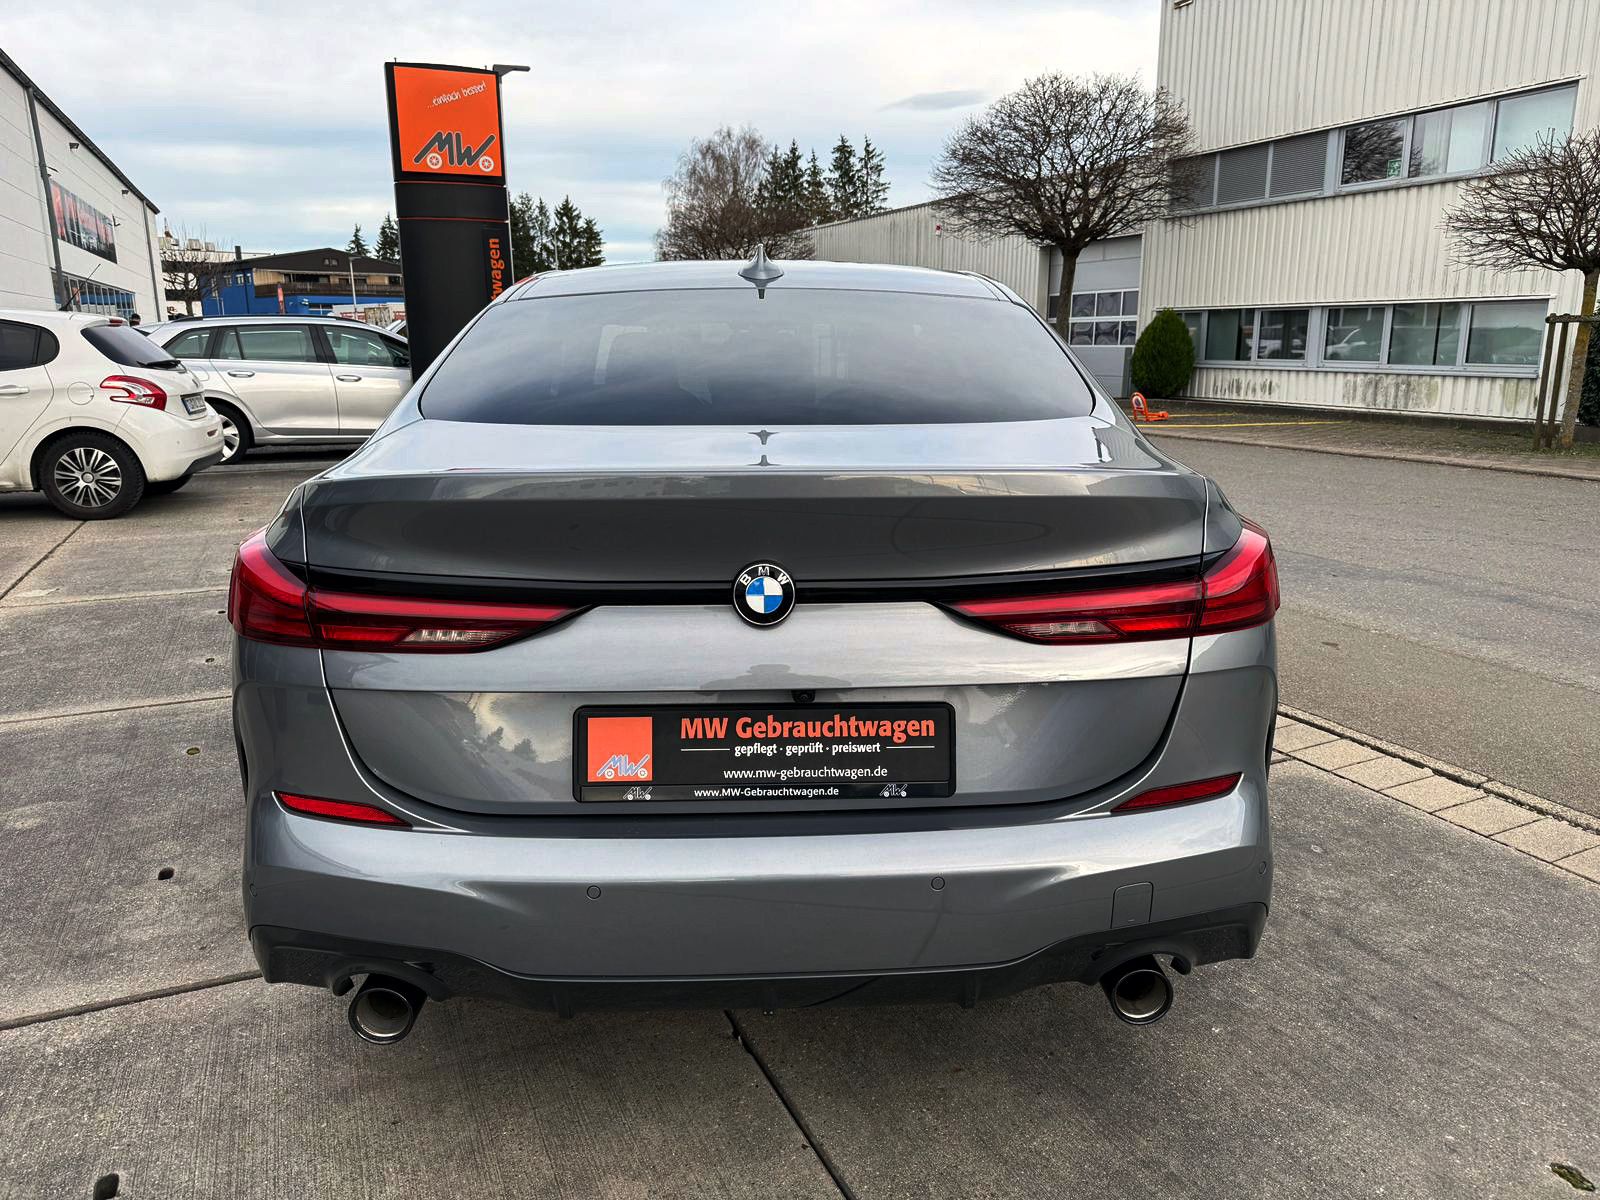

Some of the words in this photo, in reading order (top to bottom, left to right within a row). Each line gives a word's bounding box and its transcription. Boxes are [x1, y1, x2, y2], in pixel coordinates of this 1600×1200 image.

[413, 131, 496, 172] MW
[739, 566, 790, 586] BMW
[680, 717, 729, 740] MW
[735, 714, 935, 744] Gebrauchtwagen
[734, 743, 777, 757] gepflegt
[785, 742, 824, 756] geprüft
[831, 742, 881, 756] preiswert
[596, 754, 651, 779] MW
[723, 766, 888, 781] www.mw-gebrauchtwagen.de
[694, 786, 839, 798] www.MW-Gebrauchtwagen.de
